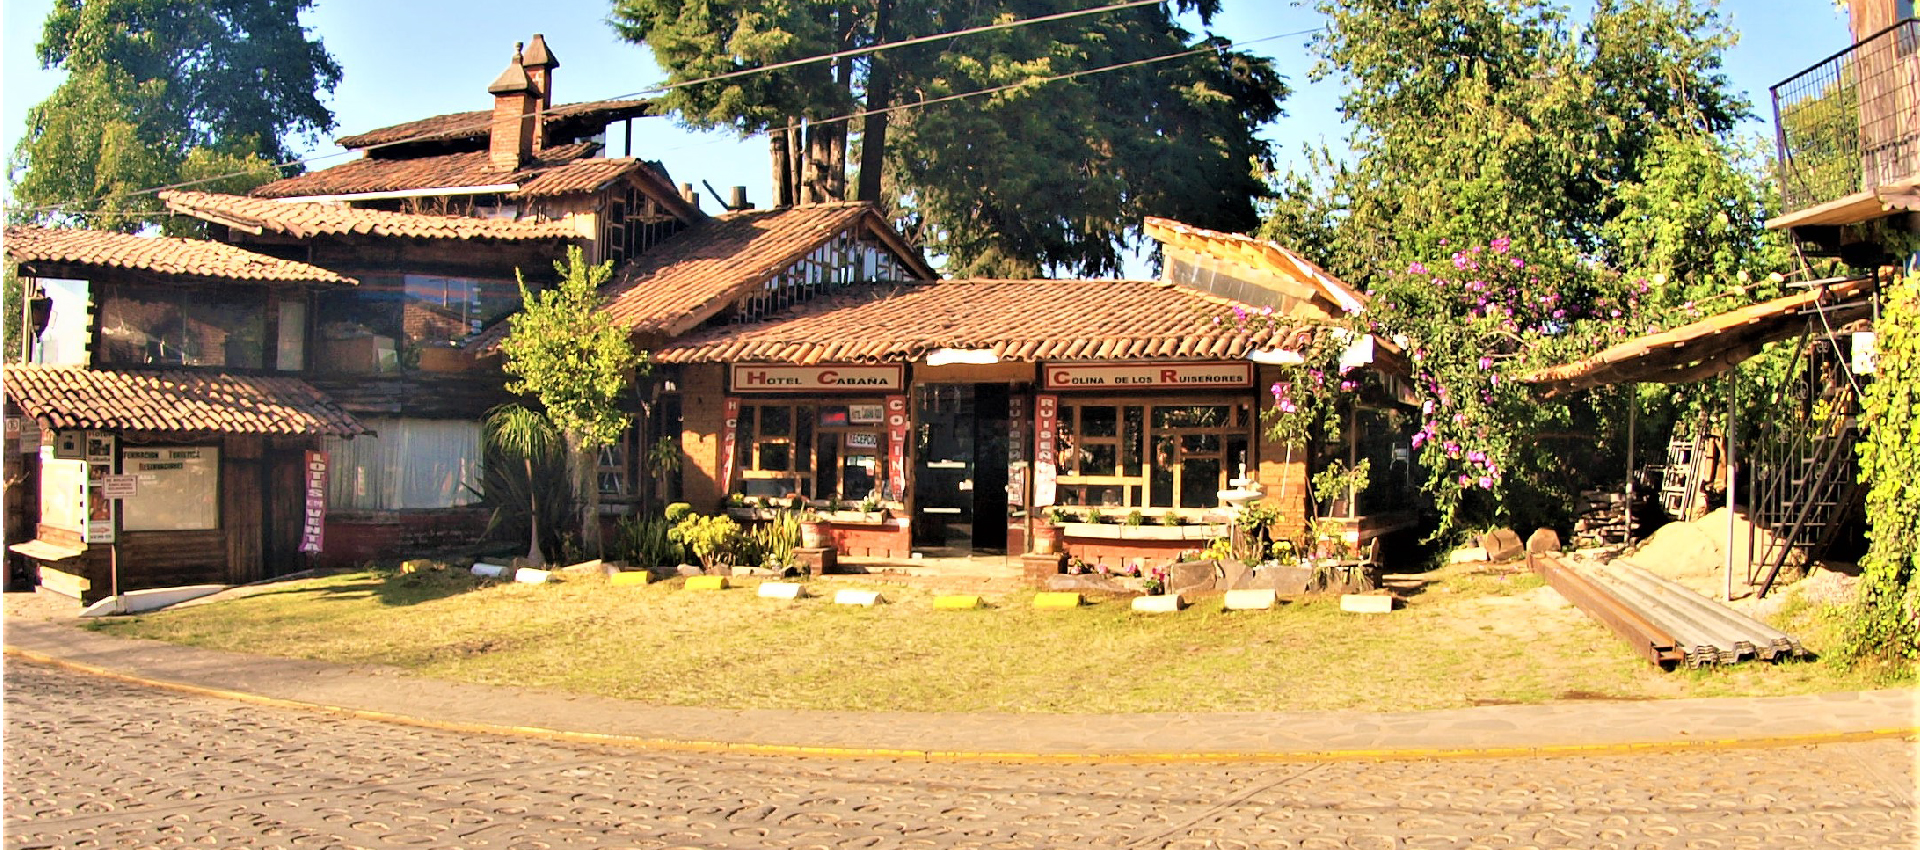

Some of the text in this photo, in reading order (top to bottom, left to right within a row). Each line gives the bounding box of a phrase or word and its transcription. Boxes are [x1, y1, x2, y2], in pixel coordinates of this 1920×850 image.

[747, 370, 888, 385] HOTEL CABAÑA
[1053, 369, 1243, 385] COLINA DE LOS RUISEÑORES
[309, 453, 326, 497] LOTES
[304, 508, 322, 552] VENTA
